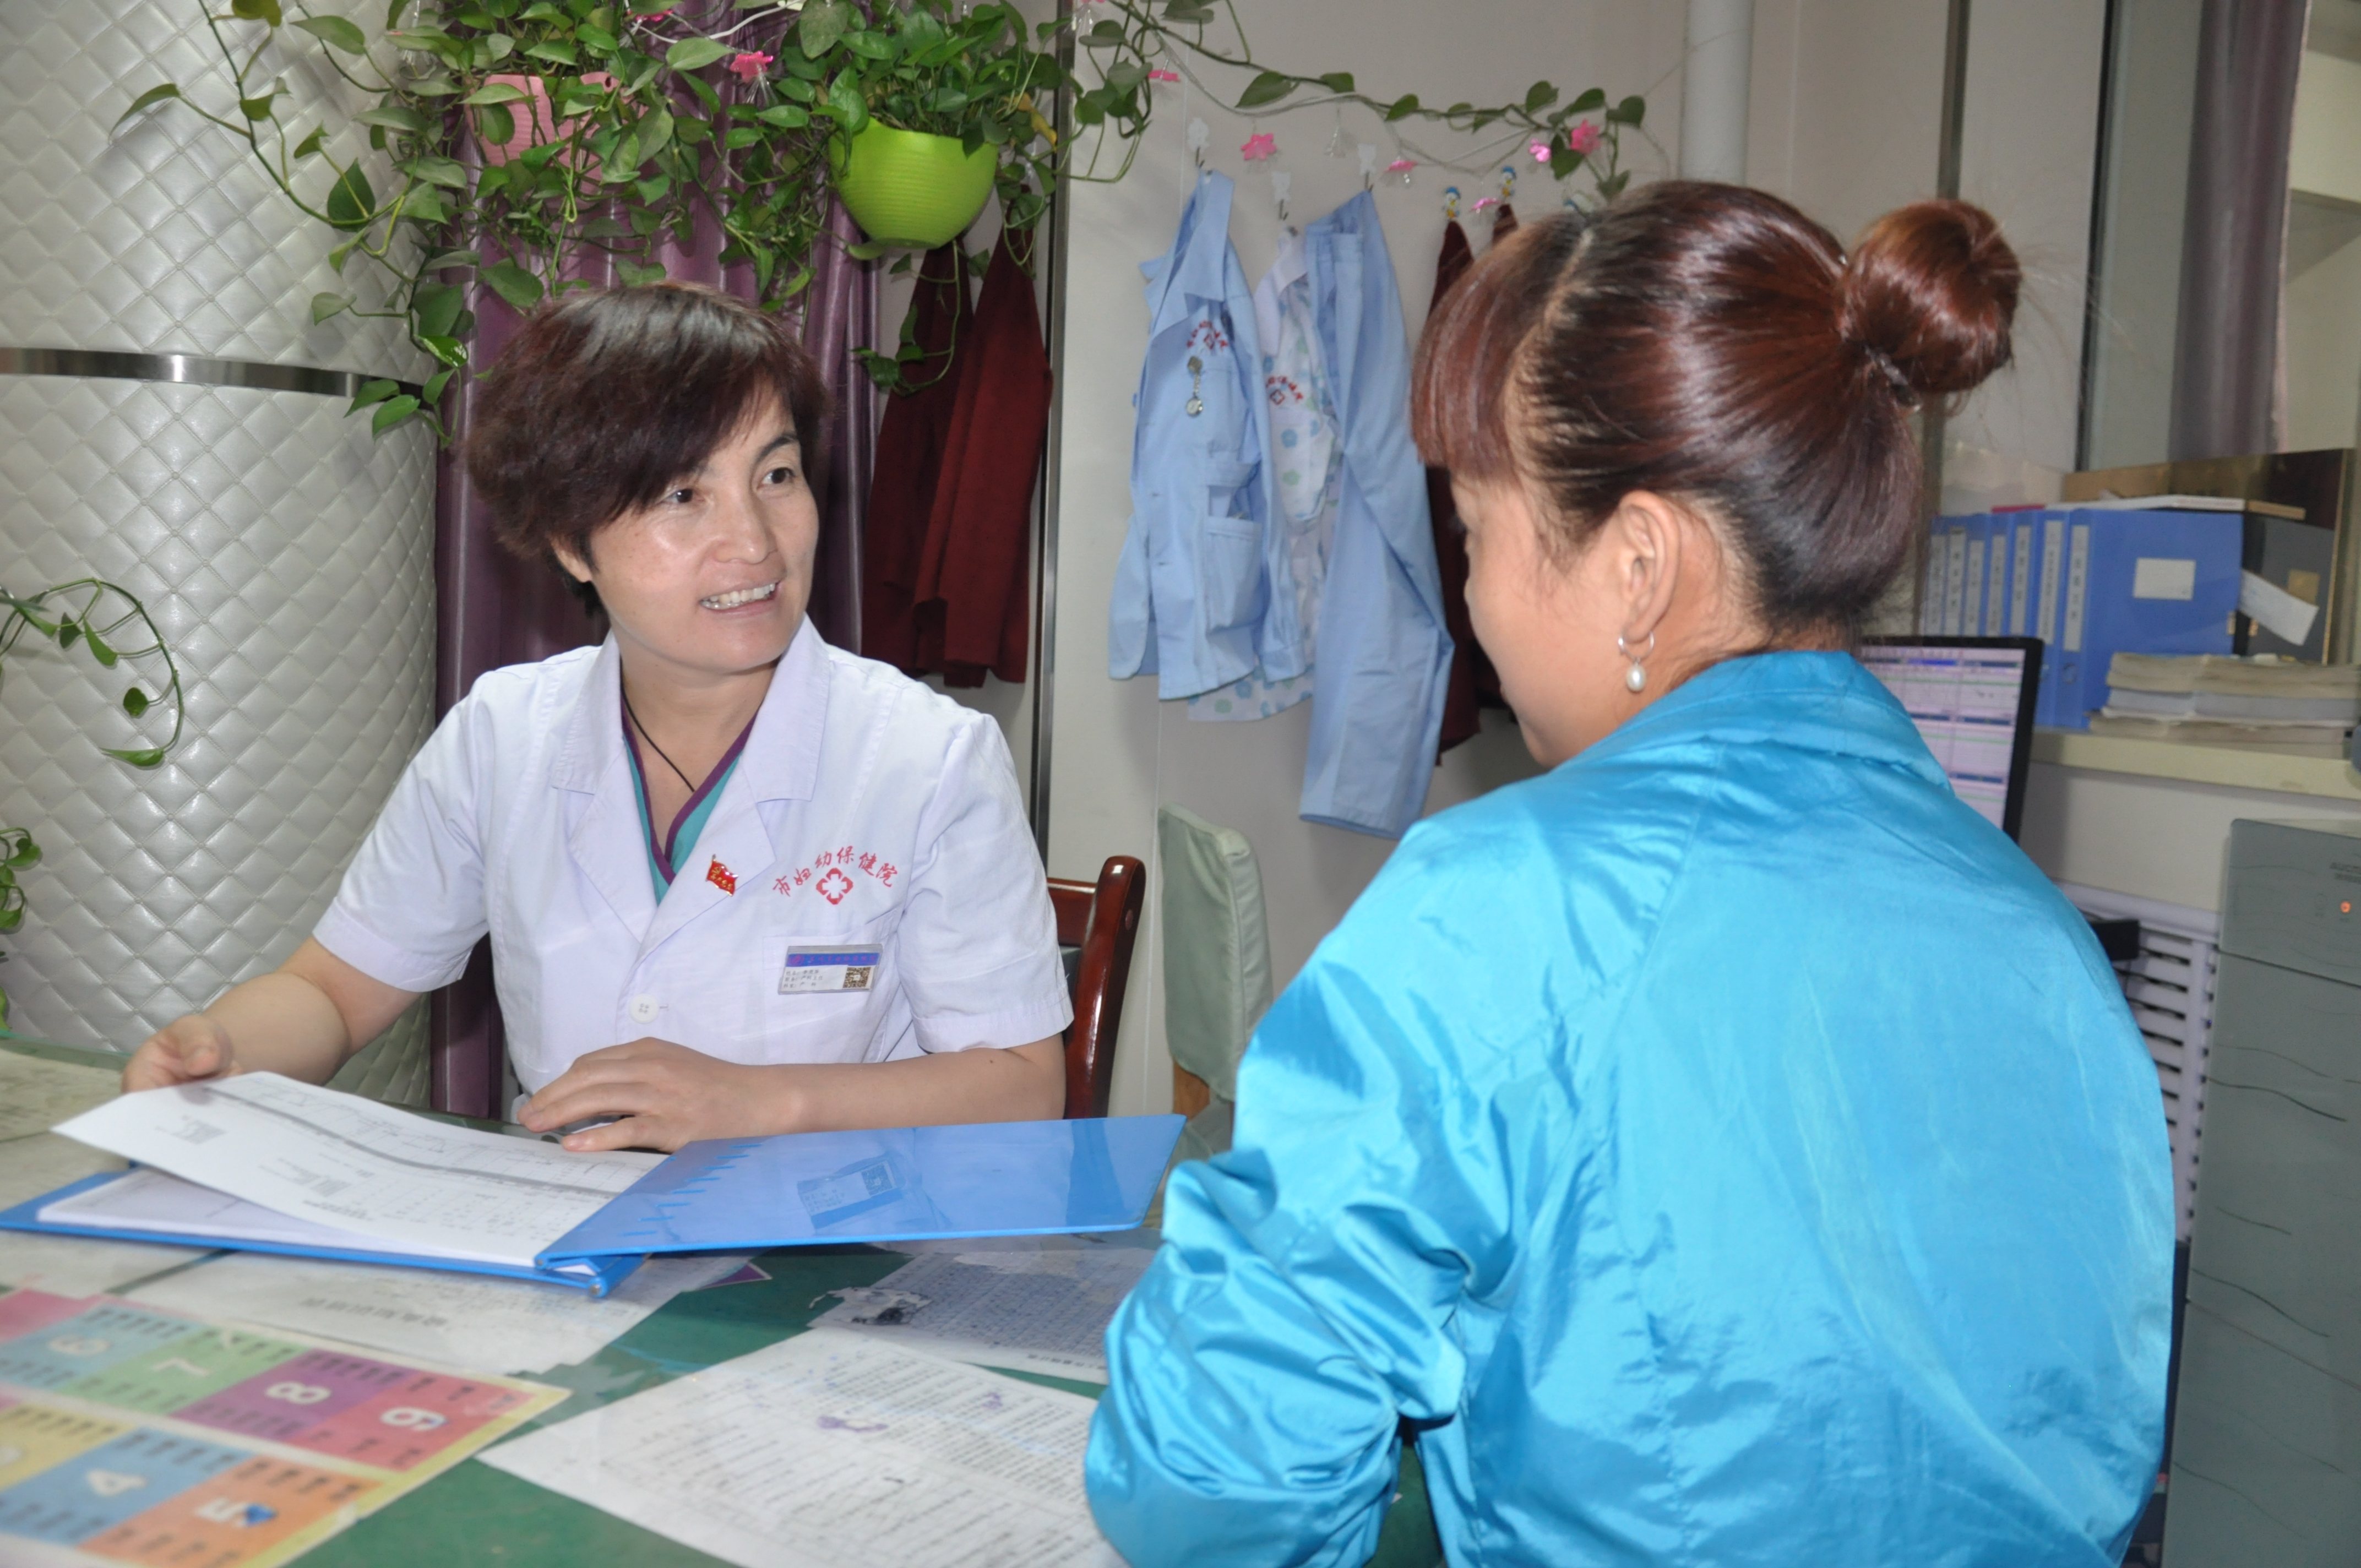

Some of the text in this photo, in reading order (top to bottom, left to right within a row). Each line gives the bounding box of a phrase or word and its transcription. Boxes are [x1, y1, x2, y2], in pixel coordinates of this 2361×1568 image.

[772, 845, 899, 897] 市妇幼保健院
[265, 1381, 331, 1404] 8
[380, 1407, 447, 1431] 9
